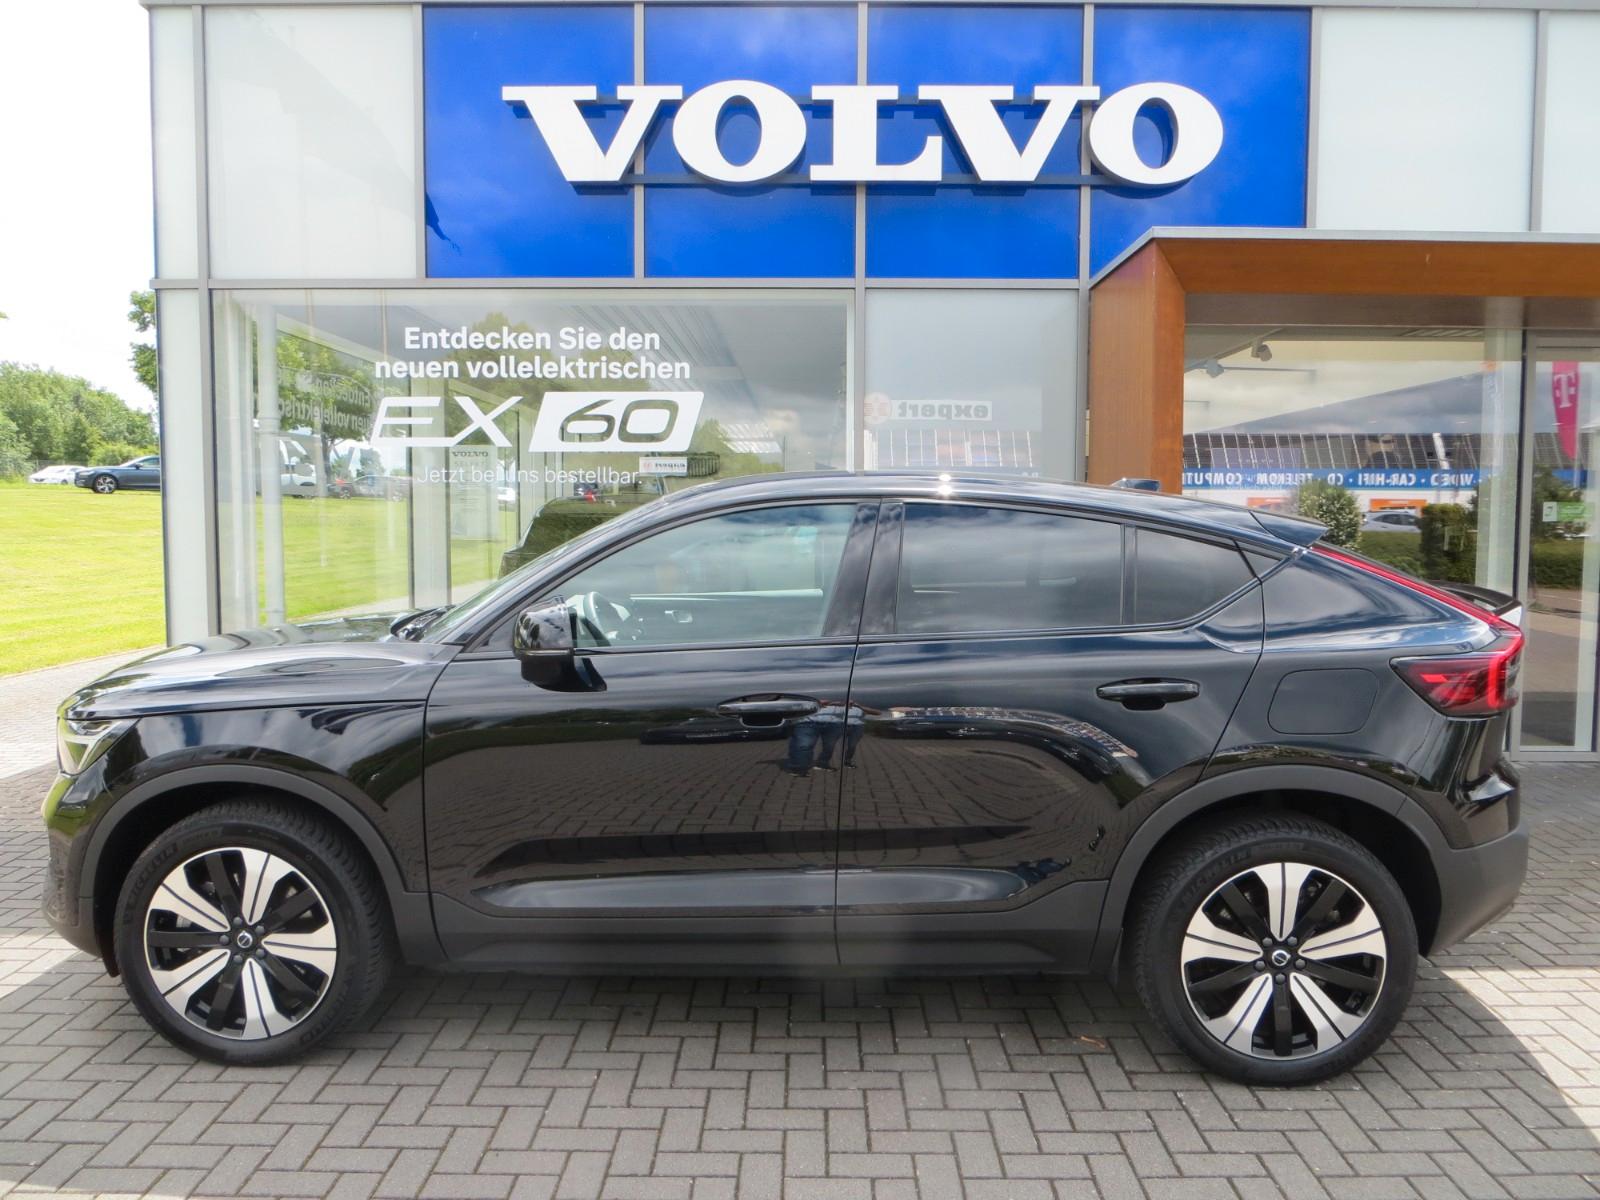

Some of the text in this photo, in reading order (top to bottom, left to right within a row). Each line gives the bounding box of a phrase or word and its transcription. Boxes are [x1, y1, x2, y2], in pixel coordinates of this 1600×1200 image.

[502, 79, 1224, 185] VOLVO
[404, 326, 660, 350] Entdecken Sie den
[375, 355, 691, 380] neuen vollelektrischen
[369, 396, 680, 448] EX 60
[417, 466, 465, 483] Jetzt
[472, 466, 499, 483] bei
[545, 466, 643, 484] bestellbar.
